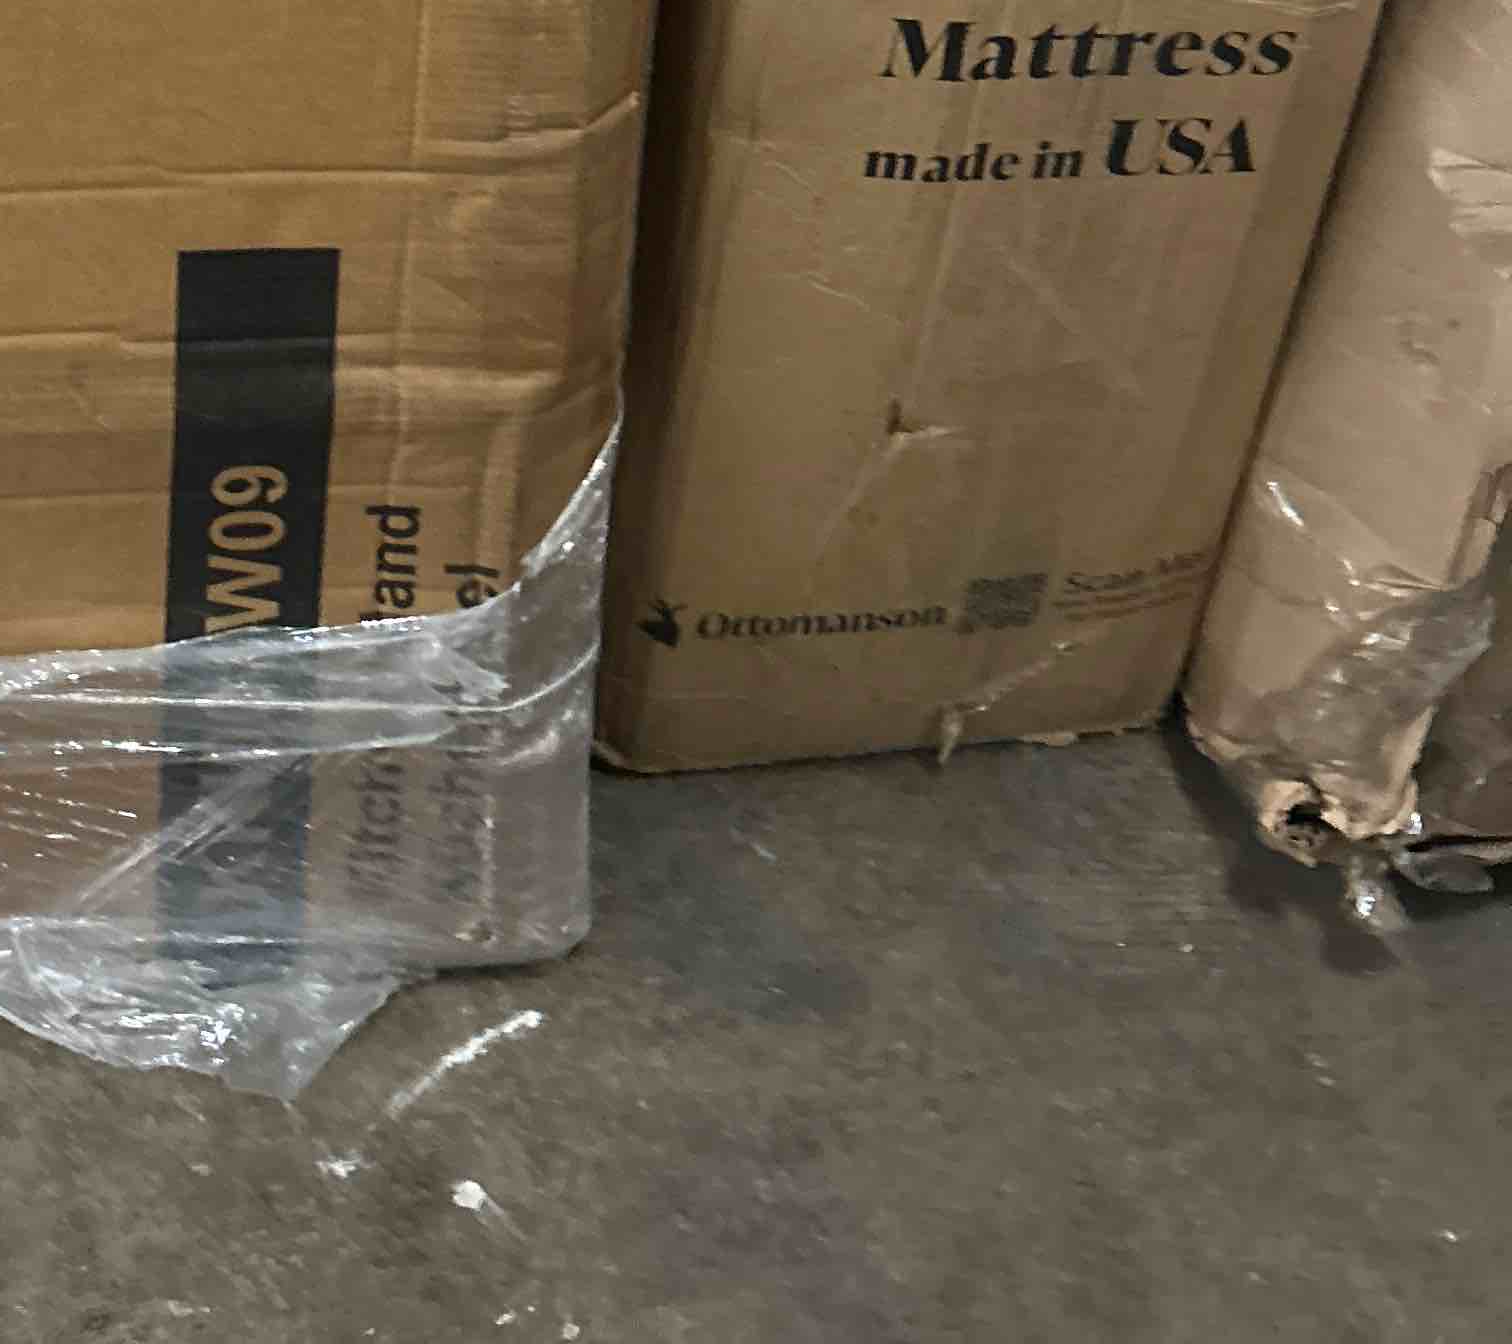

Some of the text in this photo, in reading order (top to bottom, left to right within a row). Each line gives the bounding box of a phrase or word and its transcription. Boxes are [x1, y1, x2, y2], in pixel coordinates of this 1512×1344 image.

[878, 16, 1300, 83] Mattress
[863, 116, 1258, 184] made in USA
[696, 605, 949, 642] Ottomanson
